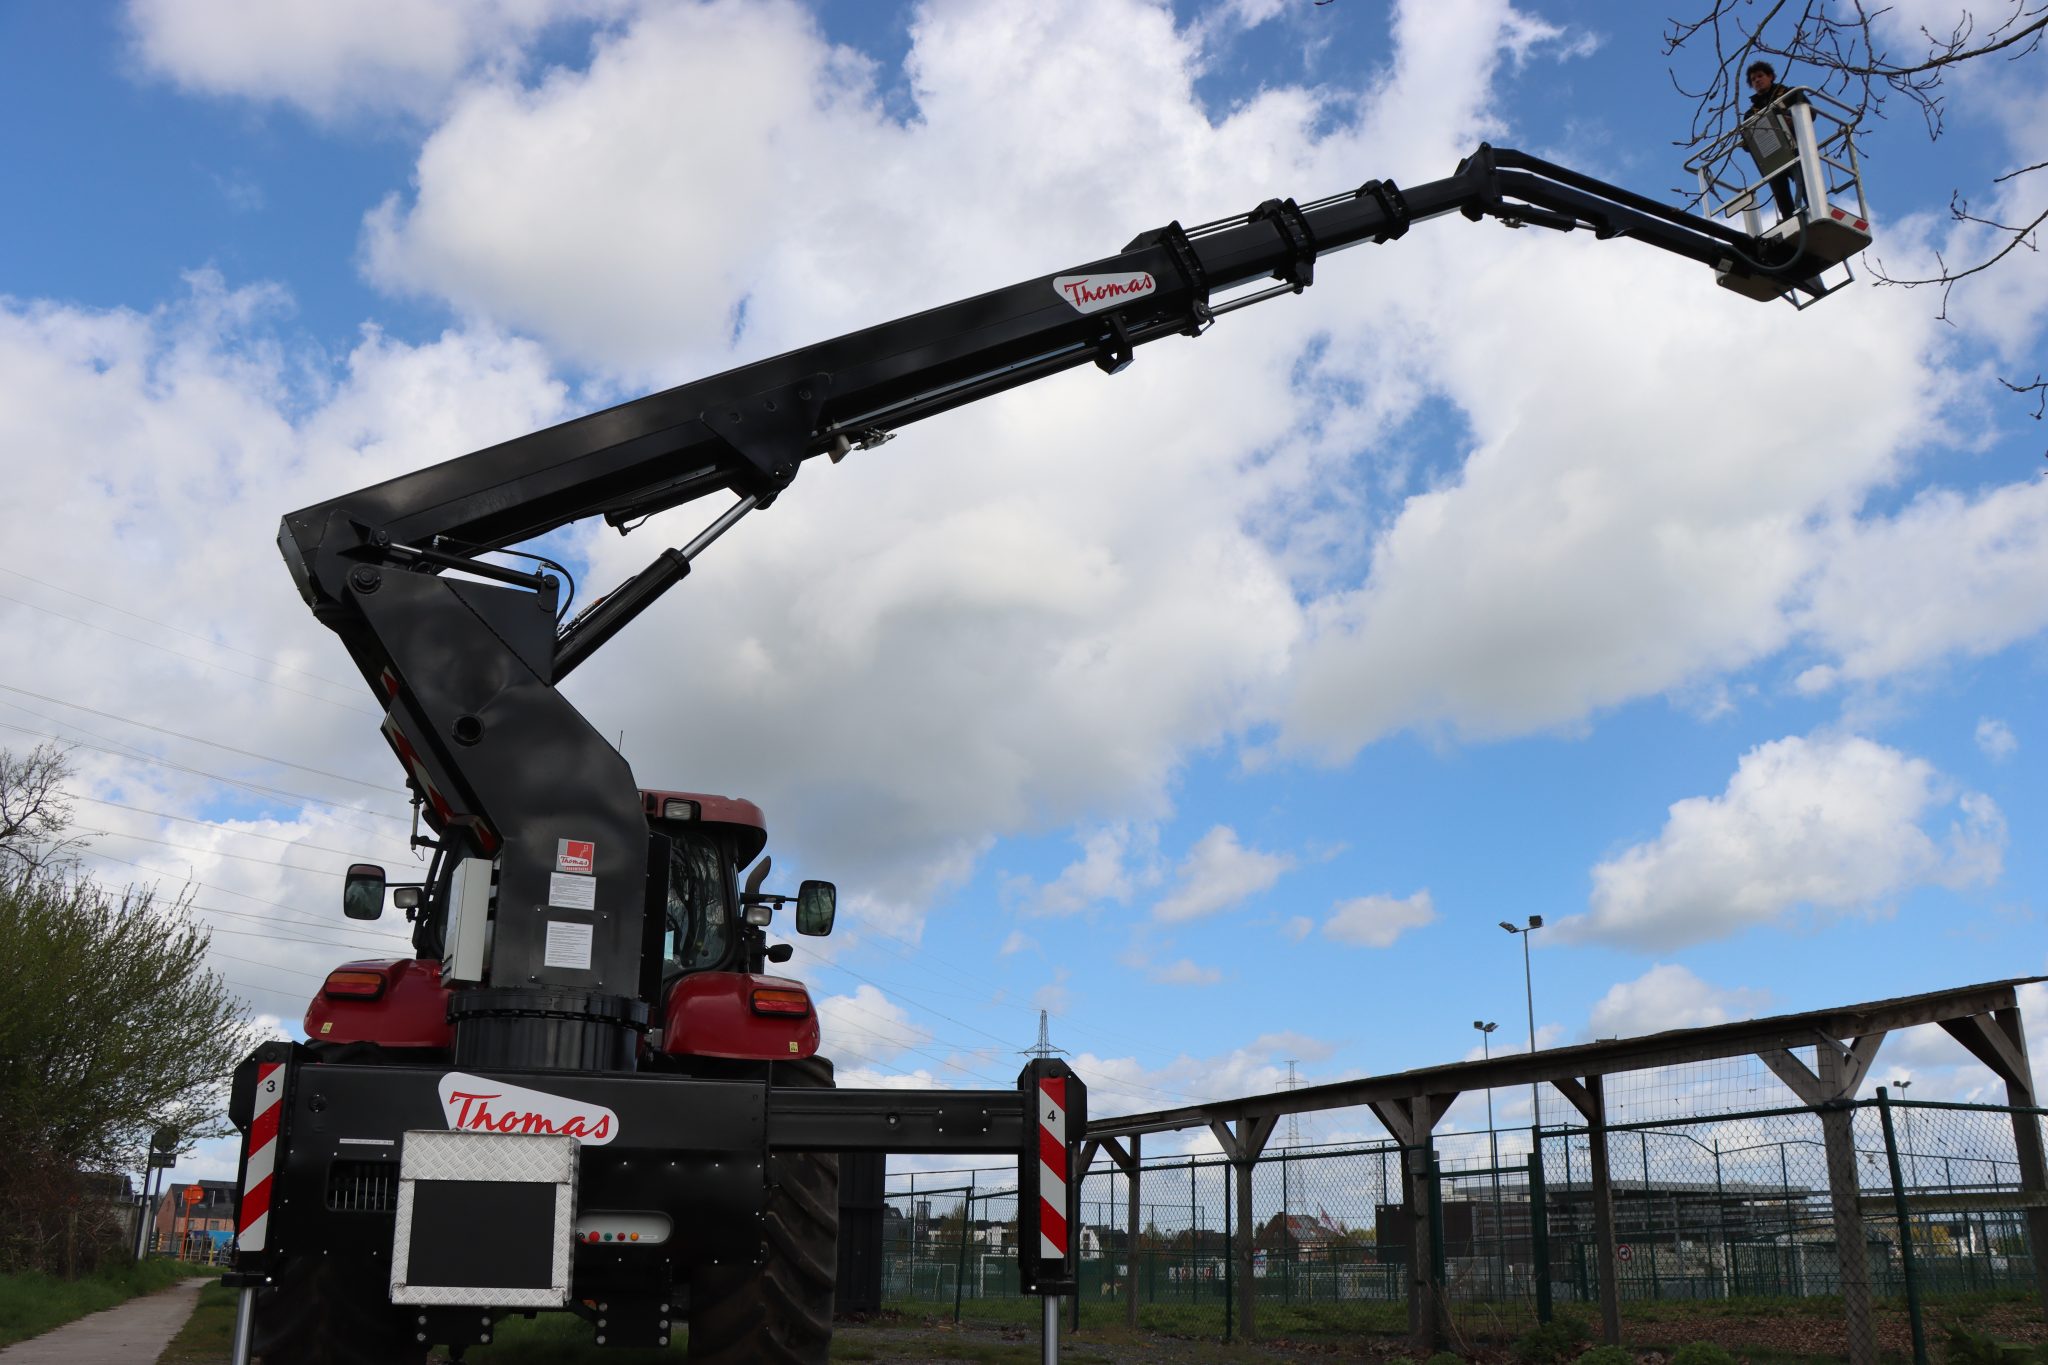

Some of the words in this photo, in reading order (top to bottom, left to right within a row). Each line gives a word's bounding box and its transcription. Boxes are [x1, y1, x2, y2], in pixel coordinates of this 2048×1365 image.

[1064, 274, 1153, 307] Thomas
[560, 856, 588, 866] Thomas
[265, 1080, 276, 1093] 3
[449, 1091, 611, 1139] Thomas
[1047, 1109, 1057, 1122] 4
